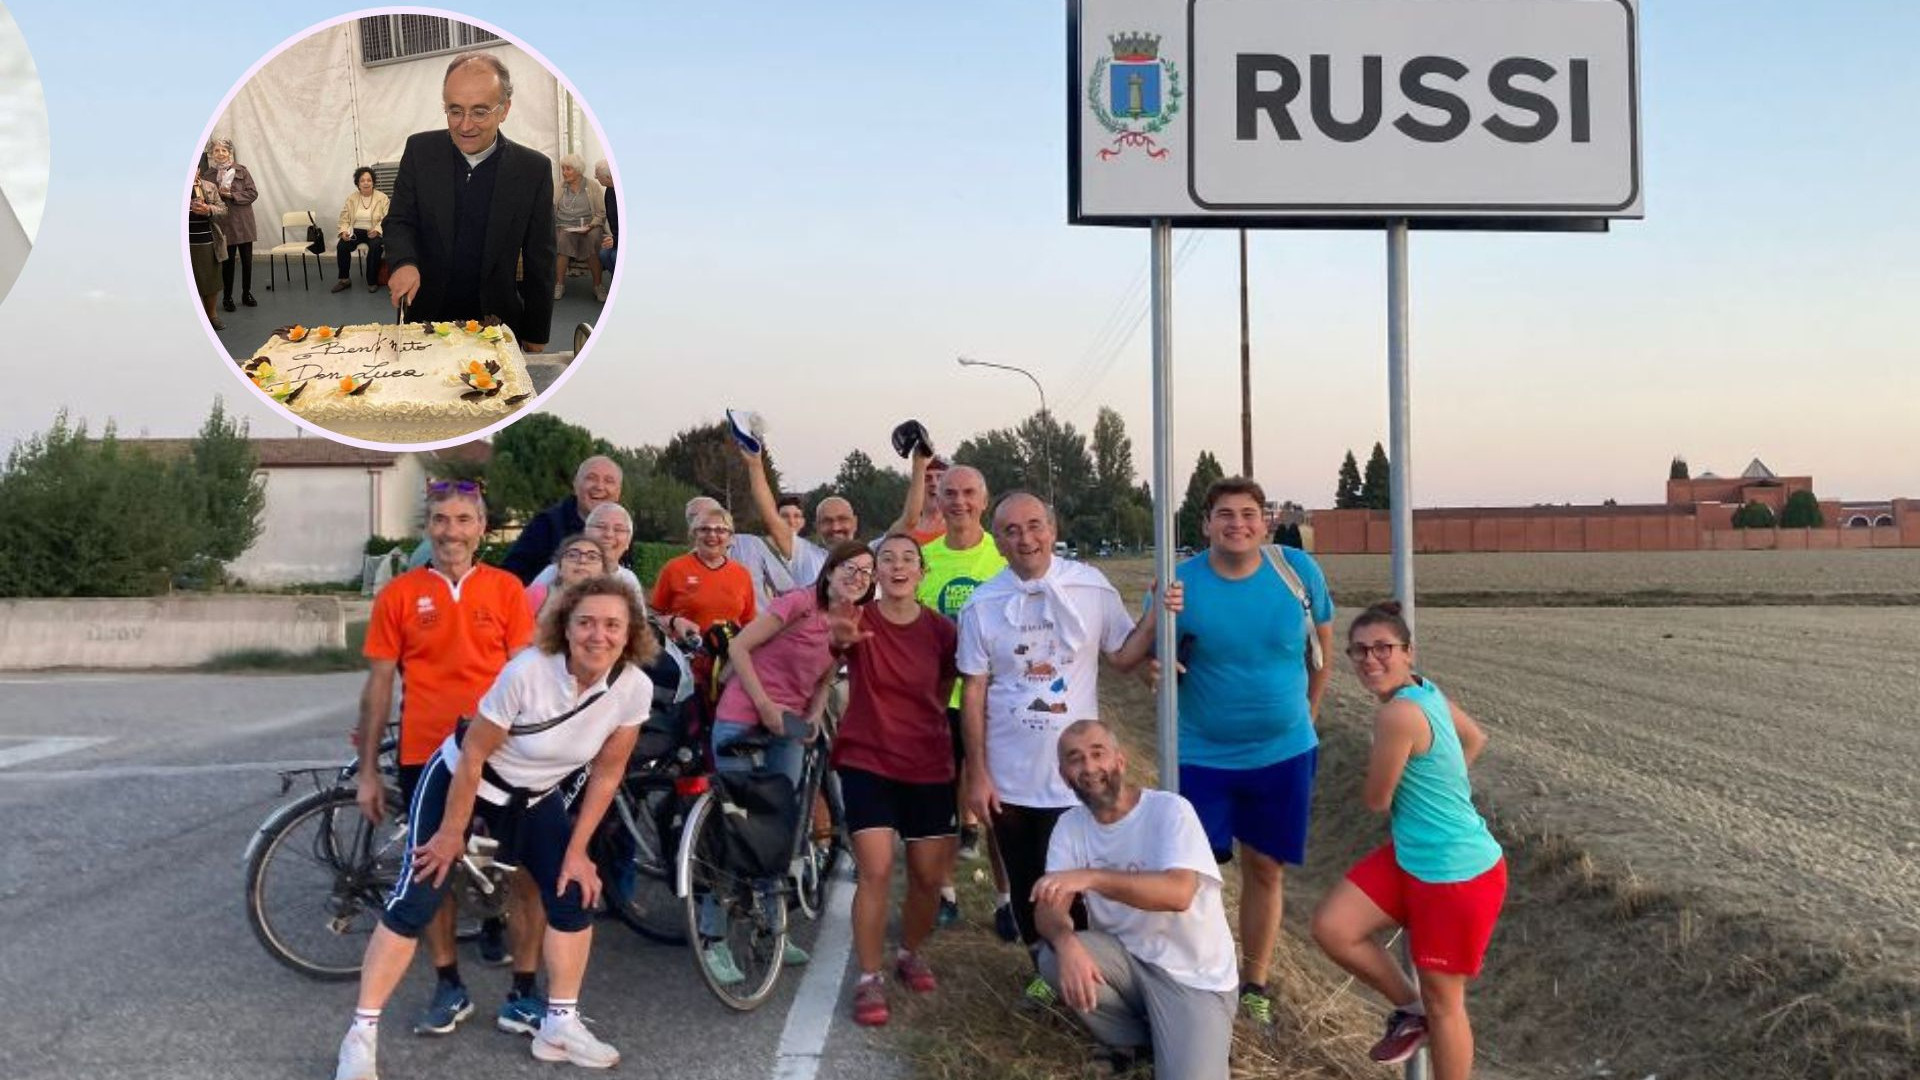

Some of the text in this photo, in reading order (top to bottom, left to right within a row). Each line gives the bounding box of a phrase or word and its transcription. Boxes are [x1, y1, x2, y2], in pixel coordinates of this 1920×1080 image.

[1235, 53, 1591, 143] RUSSI
[280, 361, 424, 384] Don Luca
